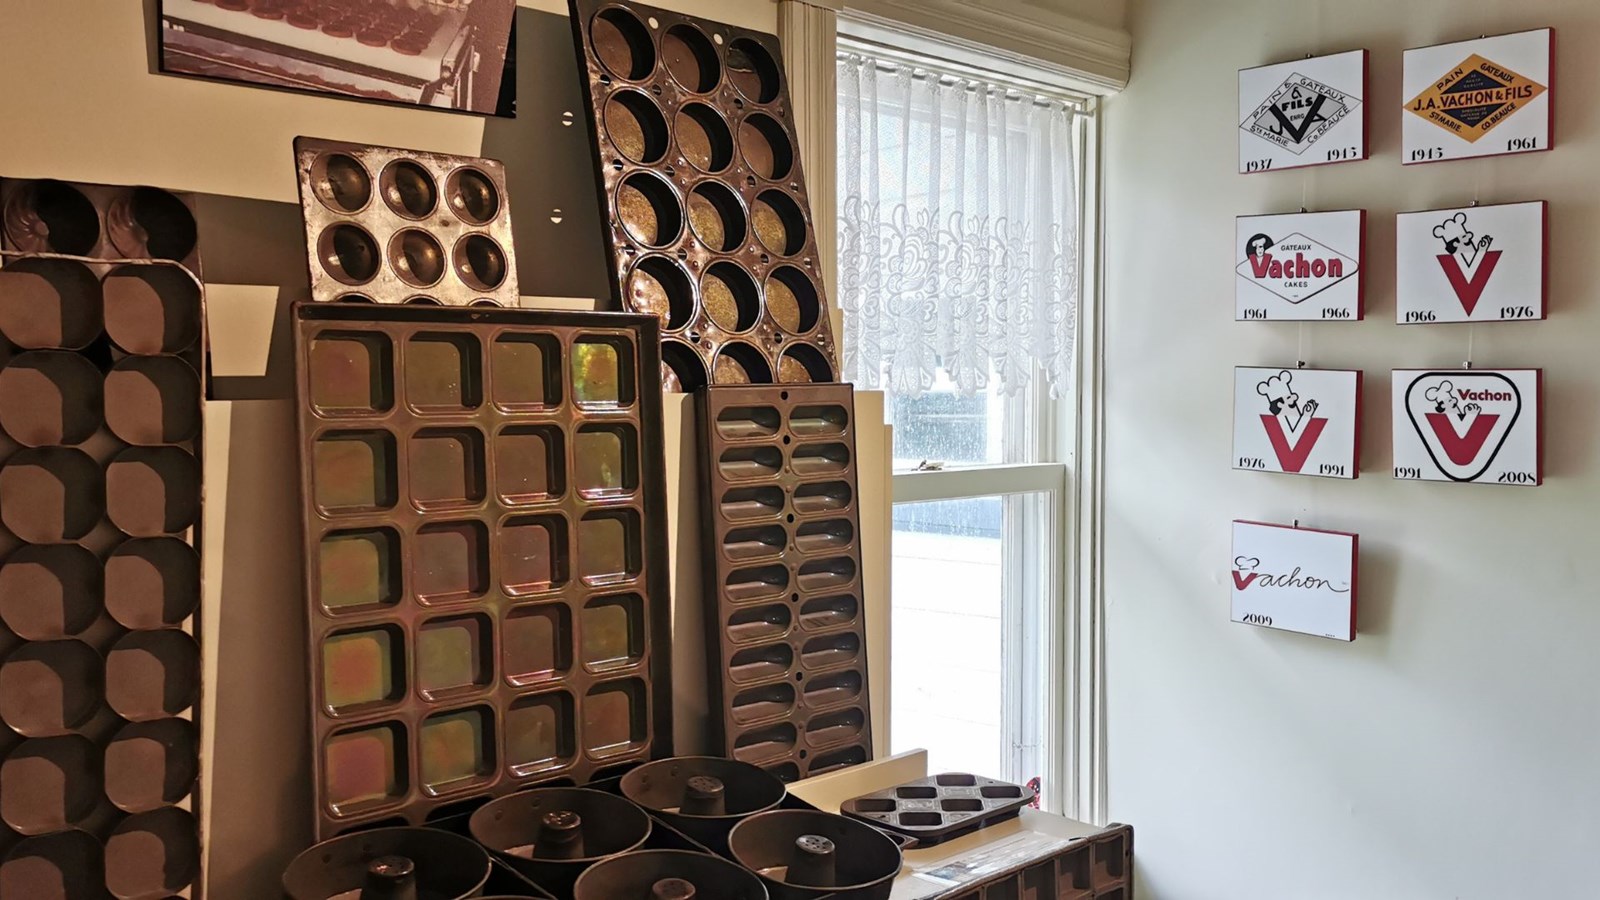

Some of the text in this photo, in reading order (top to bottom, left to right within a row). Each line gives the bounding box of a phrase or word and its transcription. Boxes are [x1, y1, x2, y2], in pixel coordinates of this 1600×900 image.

[1436, 68, 1464, 91] PAIN
[1480, 62, 1515, 84] GATEAUX
[1300, 78, 1346, 103] GATEAUX
[1440, 90, 1493, 108] VACHON
[1495, 90, 1504, 101] &
[1505, 85, 1533, 100] FILS
[1252, 90, 1282, 119] PAIN
[1281, 97, 1313, 112] FILS
[1317, 105, 1350, 136] BEAUCE
[1490, 102, 1517, 125] BEAUCE
[1262, 131, 1290, 147] MARIE
[1507, 137, 1537, 151] 1961
[1246, 158, 1272, 172] 1937
[1249, 252, 1343, 279] Vachon
[1243, 308, 1268, 319] 1961
[1322, 307, 1350, 319] 1966
[1405, 310, 1436, 322] 1966
[1500, 306, 1534, 319] 1976
[1457, 388, 1512, 402] Vachon
[1239, 457, 1265, 469] 1976
[1319, 464, 1345, 476] 1991
[1394, 467, 1421, 478] 1991
[1498, 471, 1536, 483] 2008
[1232, 566, 1349, 593] Vachon
[1242, 613, 1273, 626] 2009
